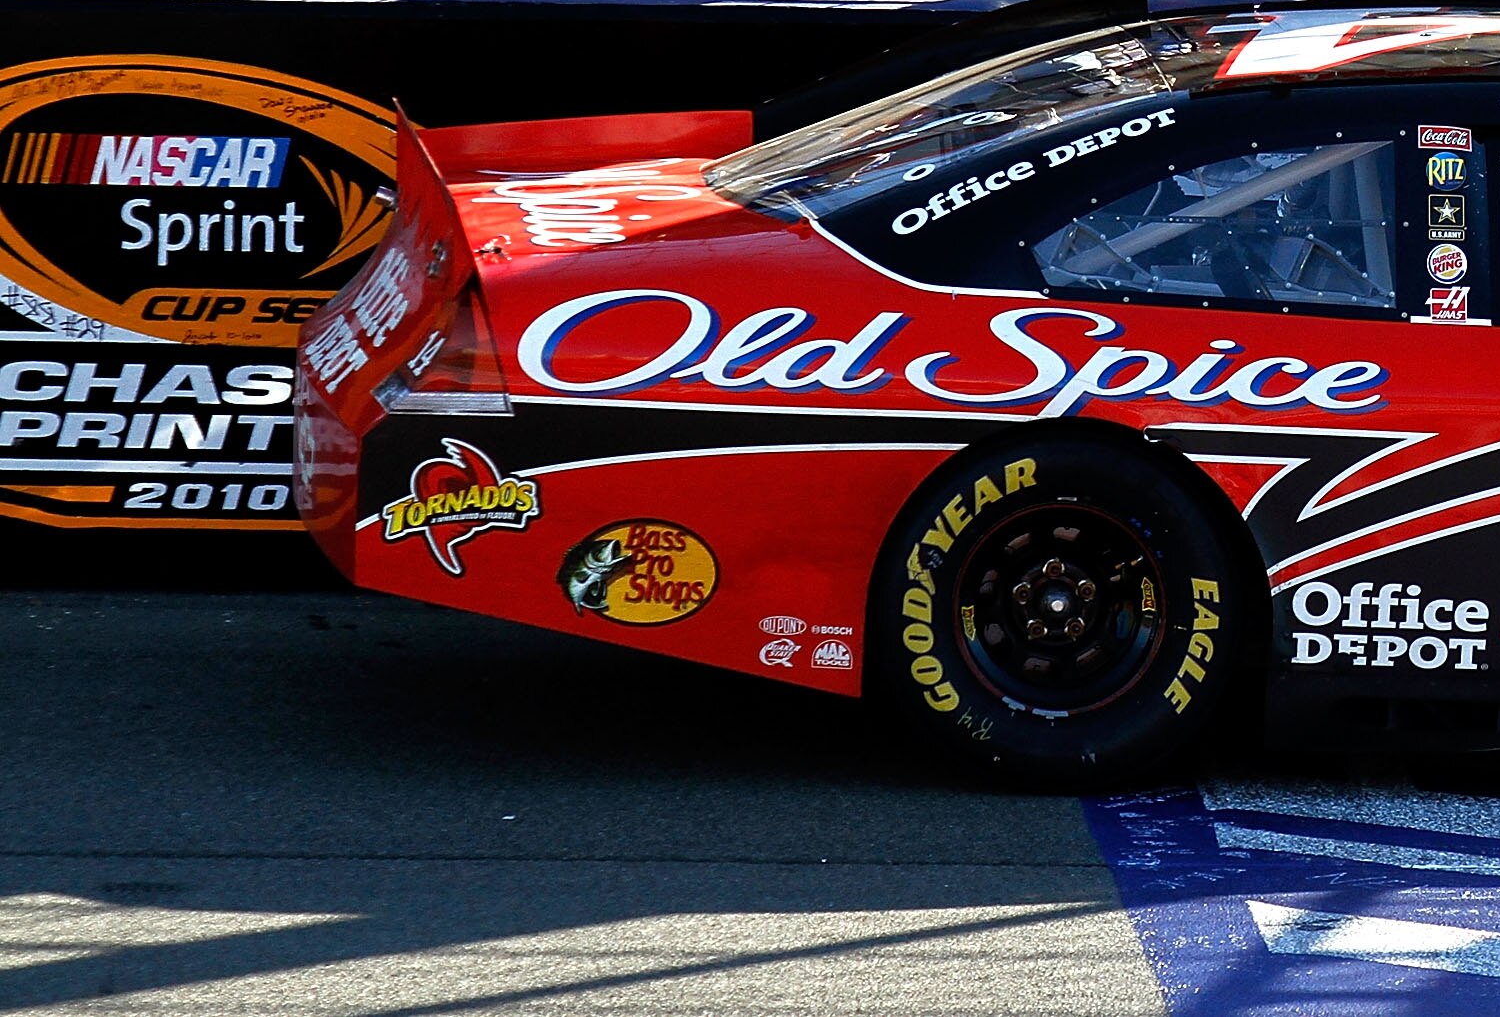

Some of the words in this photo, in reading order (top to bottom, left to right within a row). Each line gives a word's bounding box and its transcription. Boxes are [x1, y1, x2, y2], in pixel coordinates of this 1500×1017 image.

[90, 136, 275, 187] NASCAR
[891, 161, 1036, 235] Office
[1042, 107, 1176, 168] DEPOT
[1428, 158, 1463, 186] RITZ
[121, 198, 304, 266] Sprint
[1433, 251, 1461, 266] BURGER
[1434, 260, 1462, 274] KING
[142, 295, 246, 321] CUP
[1437, 310, 1463, 320] HAAS
[517, 288, 911, 396] Old
[904, 306, 1390, 419] Spice
[124, 483, 288, 510] 2010
[387, 481, 533, 533] TORNADOS
[624, 523, 687, 552] Bass
[631, 549, 674, 576] Pro
[625, 574, 705, 610] Shops
[1291, 581, 1490, 632] Office
[821, 626, 852, 635] BOSCH
[815, 643, 850, 660] MAC
[1163, 577, 1221, 714] EAGLE
[1291, 633, 1486, 670] DEPOT
